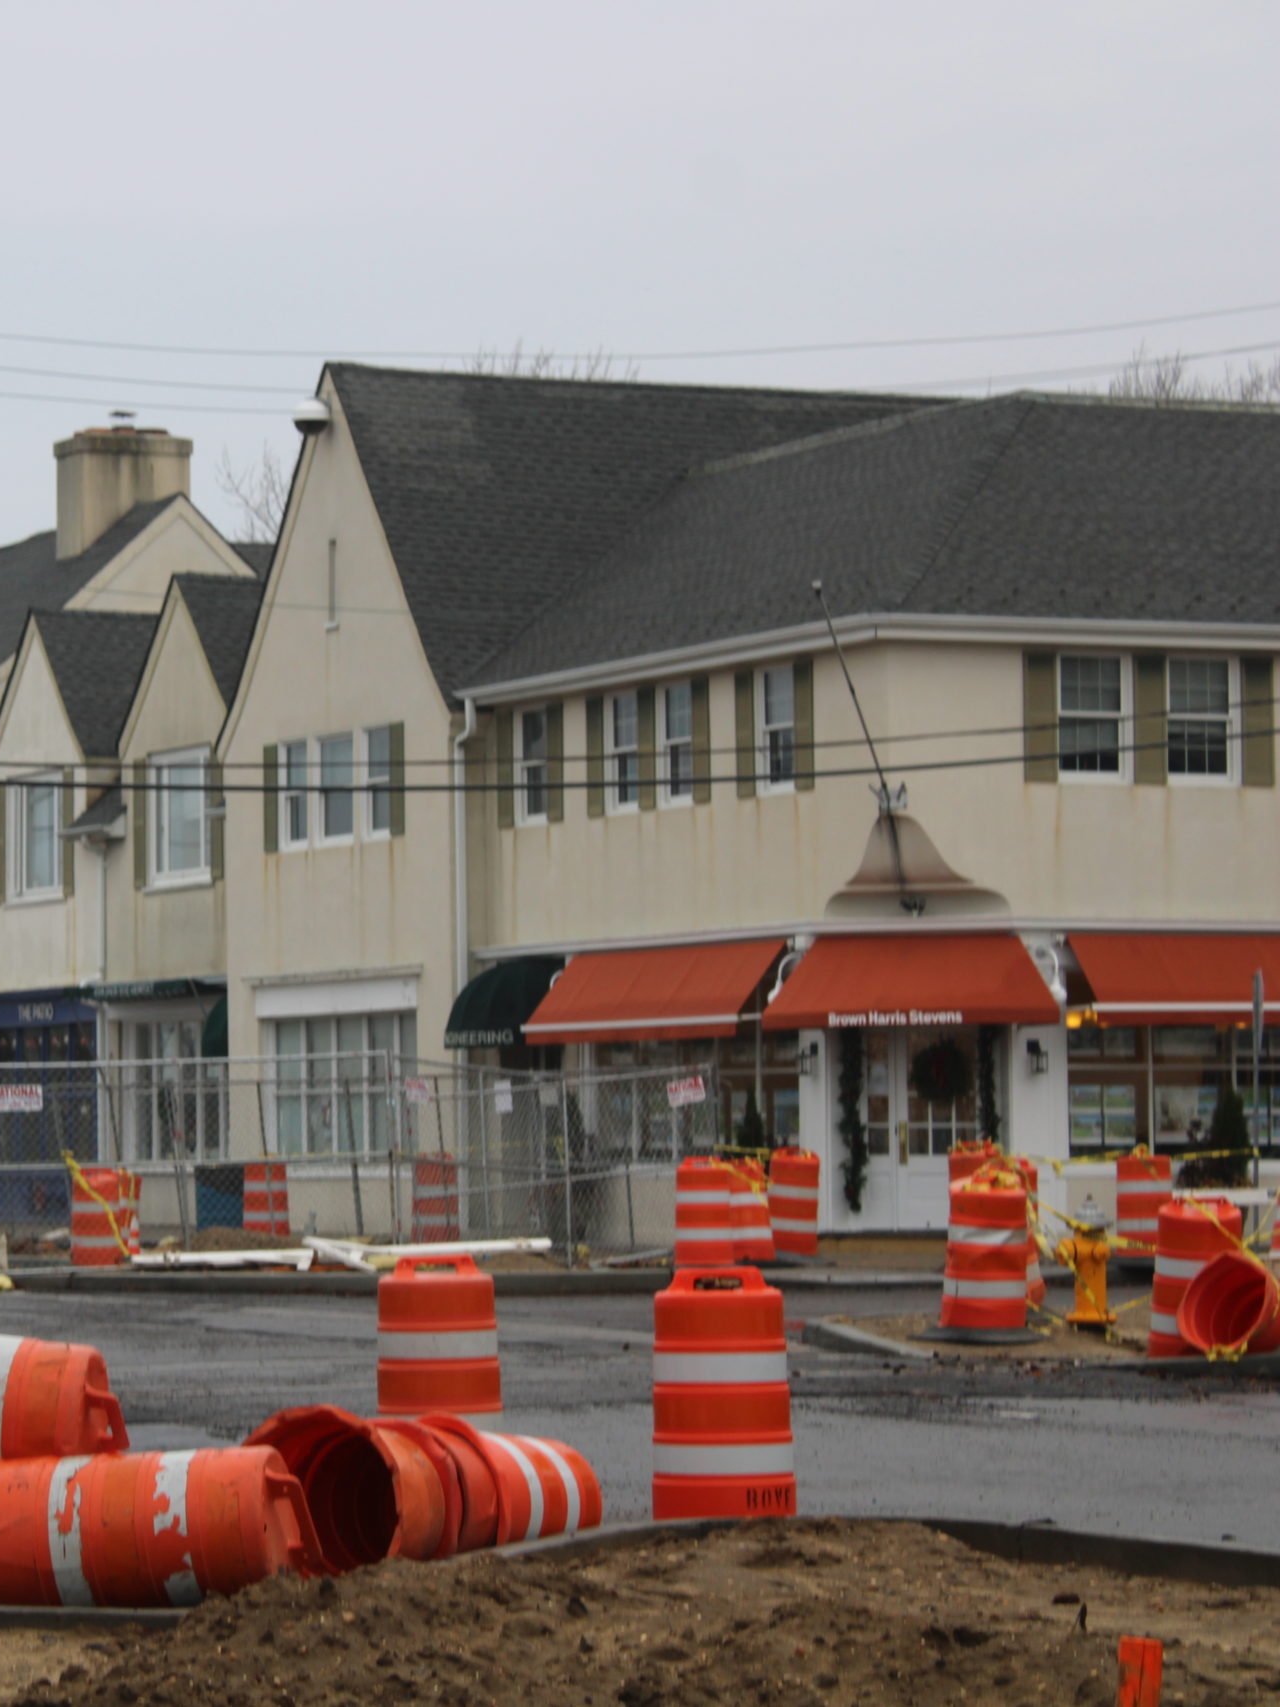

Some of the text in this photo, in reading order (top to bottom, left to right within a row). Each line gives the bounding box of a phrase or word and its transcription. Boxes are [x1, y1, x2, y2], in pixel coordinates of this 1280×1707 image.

[828, 1009, 962, 1027] Brown Harris Stevens
